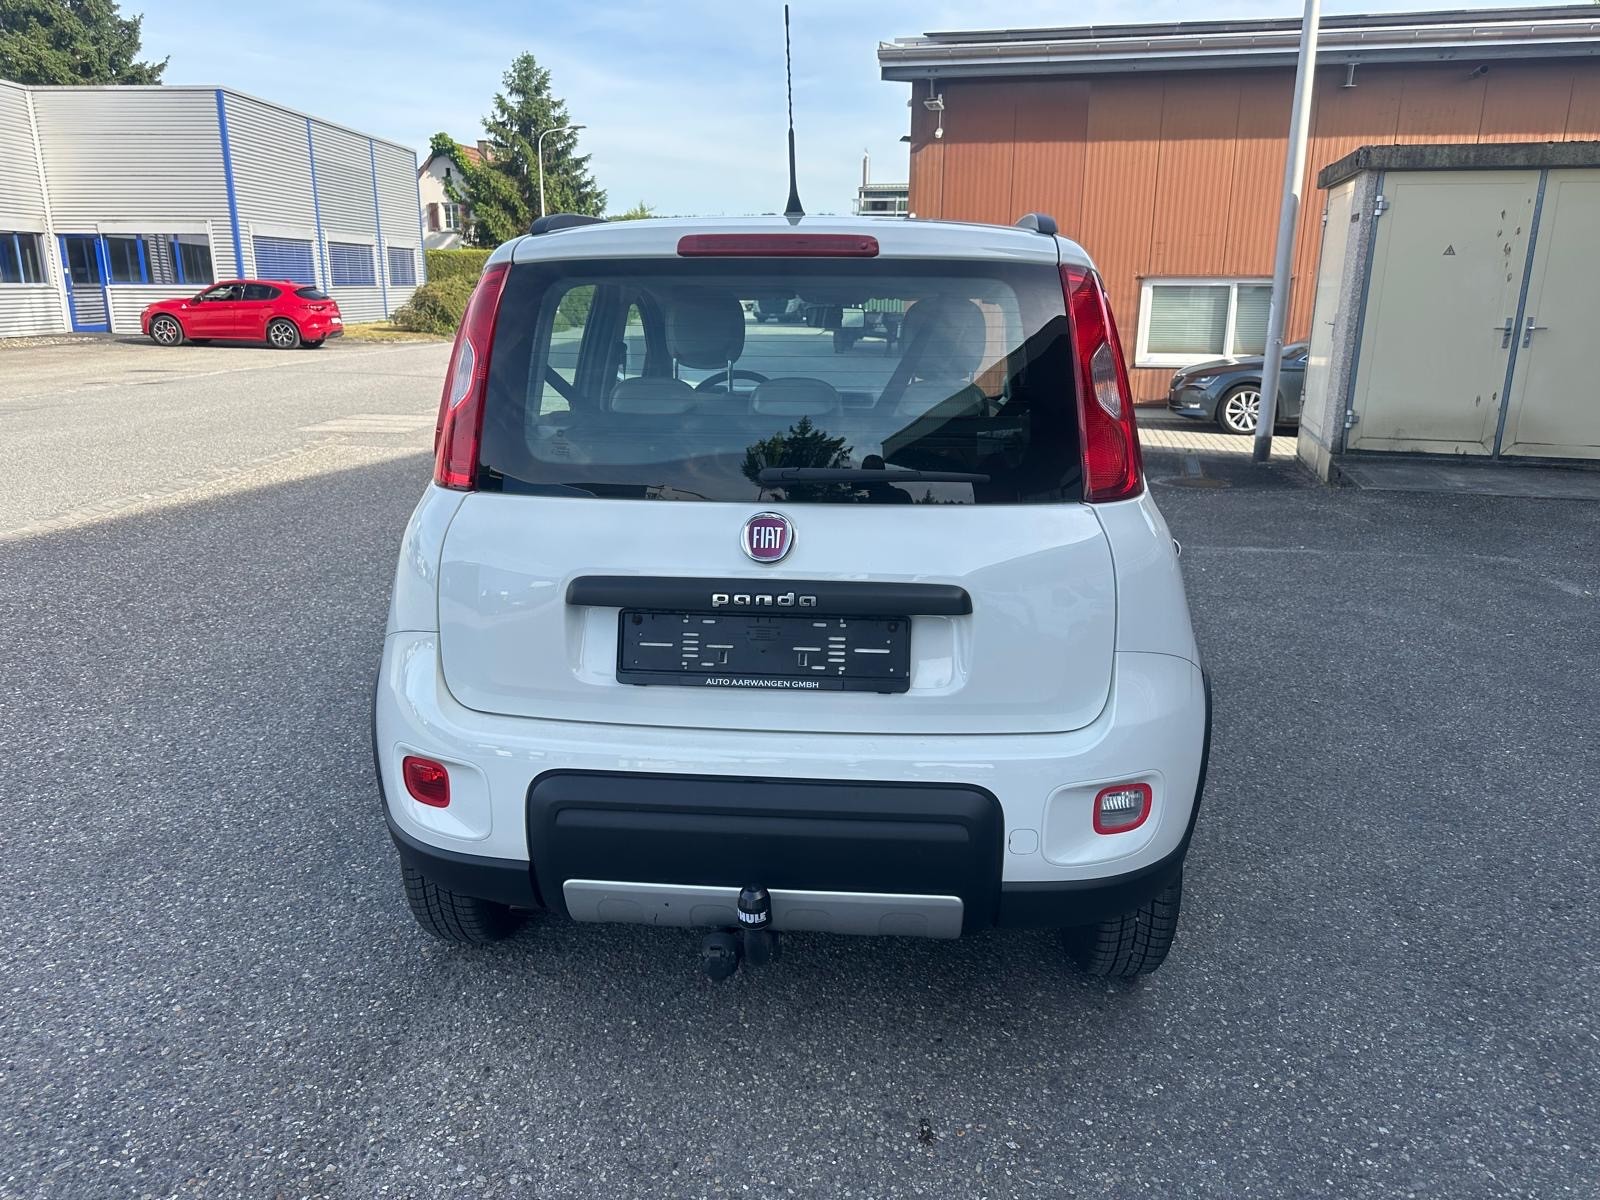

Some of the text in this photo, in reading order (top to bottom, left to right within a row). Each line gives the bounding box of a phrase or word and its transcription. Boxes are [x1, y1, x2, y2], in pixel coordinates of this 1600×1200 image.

[753, 526, 783, 549] FIAT
[712, 592, 817, 607] panda
[731, 679, 790, 687] AARWANGEN
[792, 680, 819, 688] GMBH
